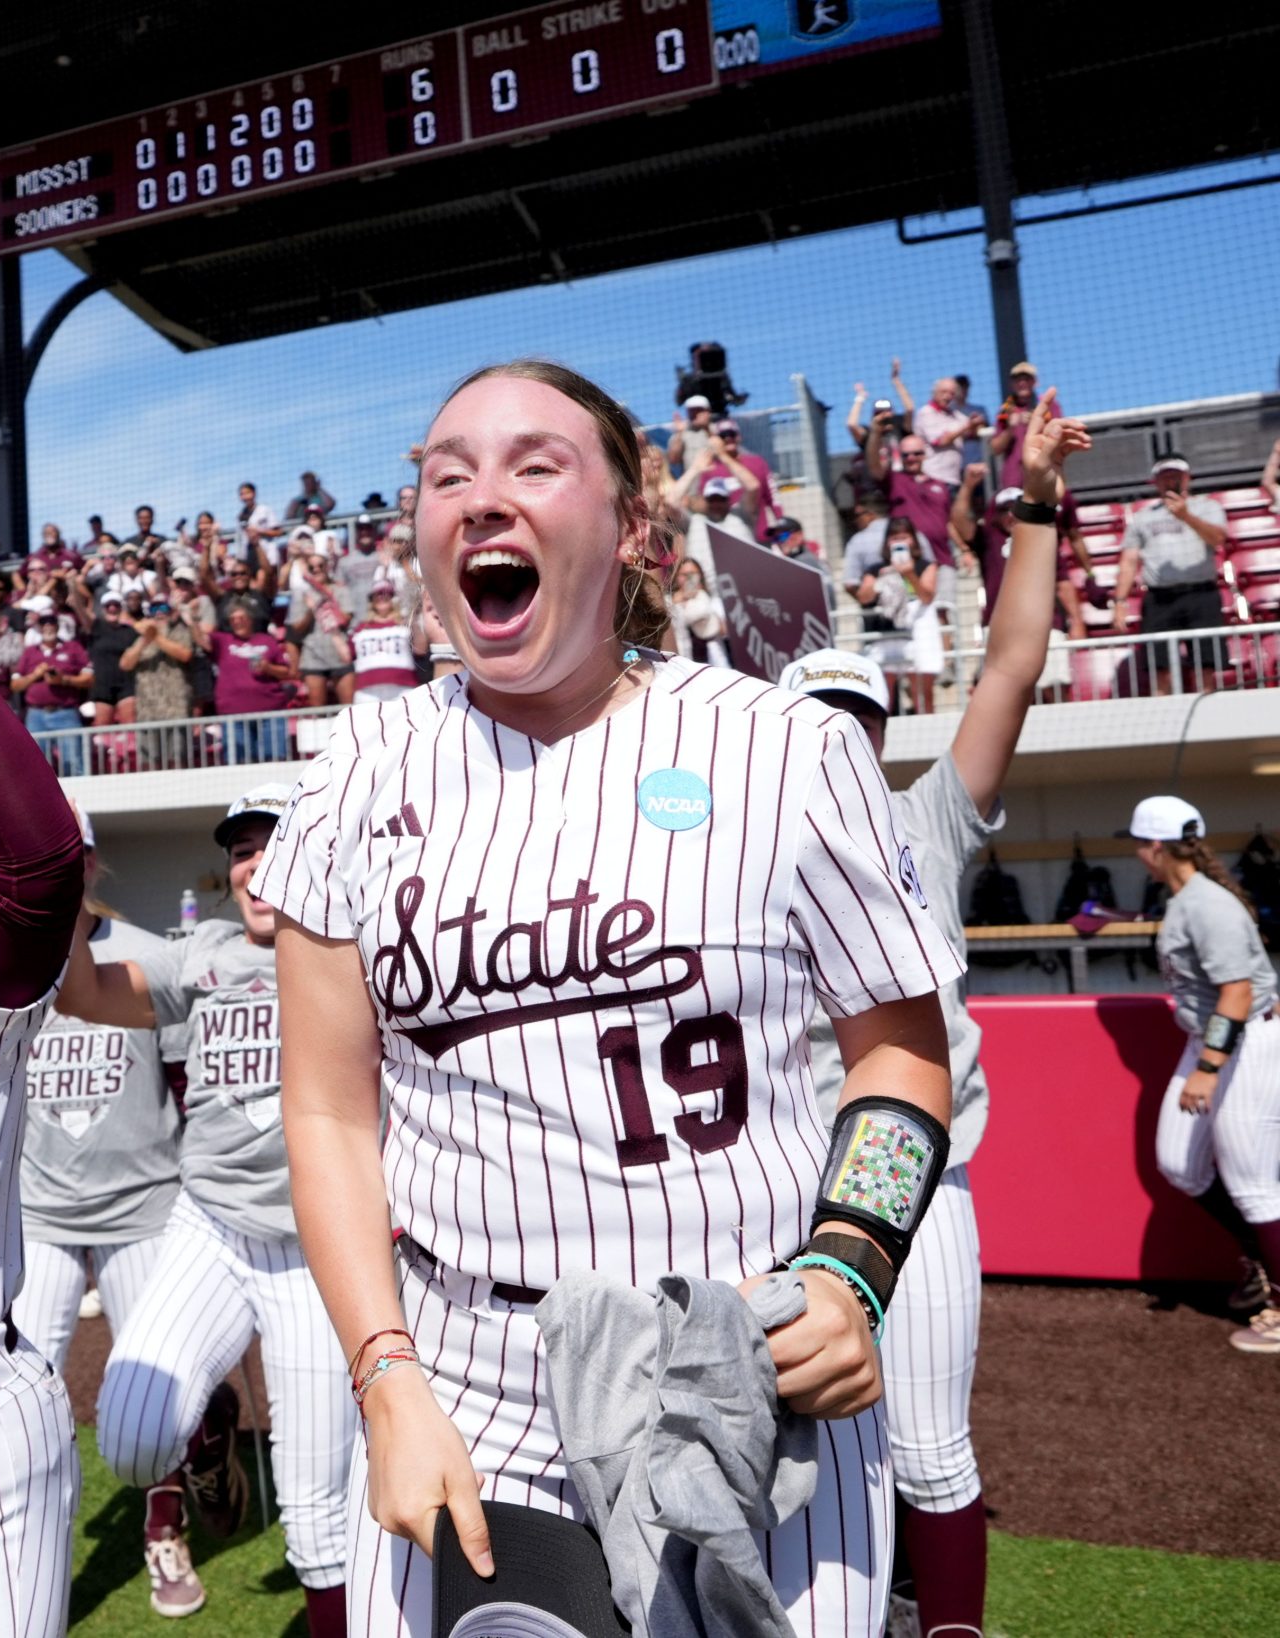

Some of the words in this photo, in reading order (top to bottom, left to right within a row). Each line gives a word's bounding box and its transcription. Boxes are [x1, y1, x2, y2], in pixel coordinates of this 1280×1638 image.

[472, 26, 528, 57] BALL
[542, 2, 624, 39] STRIKE
[490, 69, 518, 112] 0
[571, 49, 600, 93] 0
[655, 28, 685, 73] 0
[139, 117, 150, 133] 1
[165, 109, 179, 127] 2
[195, 101, 208, 118] 3
[232, 90, 245, 107] 4
[261, 82, 275, 101] 5
[292, 75, 305, 93] 6
[329, 65, 342, 83] 7
[380, 42, 435, 71] RUNS
[15, 155, 93, 198] MISSST
[135, 138, 156, 170] 0
[176, 131, 186, 158] 1
[207, 124, 217, 151] 1
[230, 114, 250, 146] 2
[261, 105, 281, 139] 0
[292, 98, 314, 131] 0
[411, 68, 434, 102] 6
[15, 195, 99, 237] SOONERS
[137, 177, 157, 210] 0
[167, 170, 187, 202] 0
[196, 163, 217, 195] 0
[231, 154, 252, 188] 0
[263, 147, 283, 180] 0
[294, 139, 315, 173] 0
[413, 111, 436, 145] 0
[646, 796, 707, 815] NCAA
[373, 876, 702, 1020] State
[201, 1004, 280, 1046] WOR
[204, 1047, 281, 1085] SERI
[597, 1011, 749, 1167] 19
